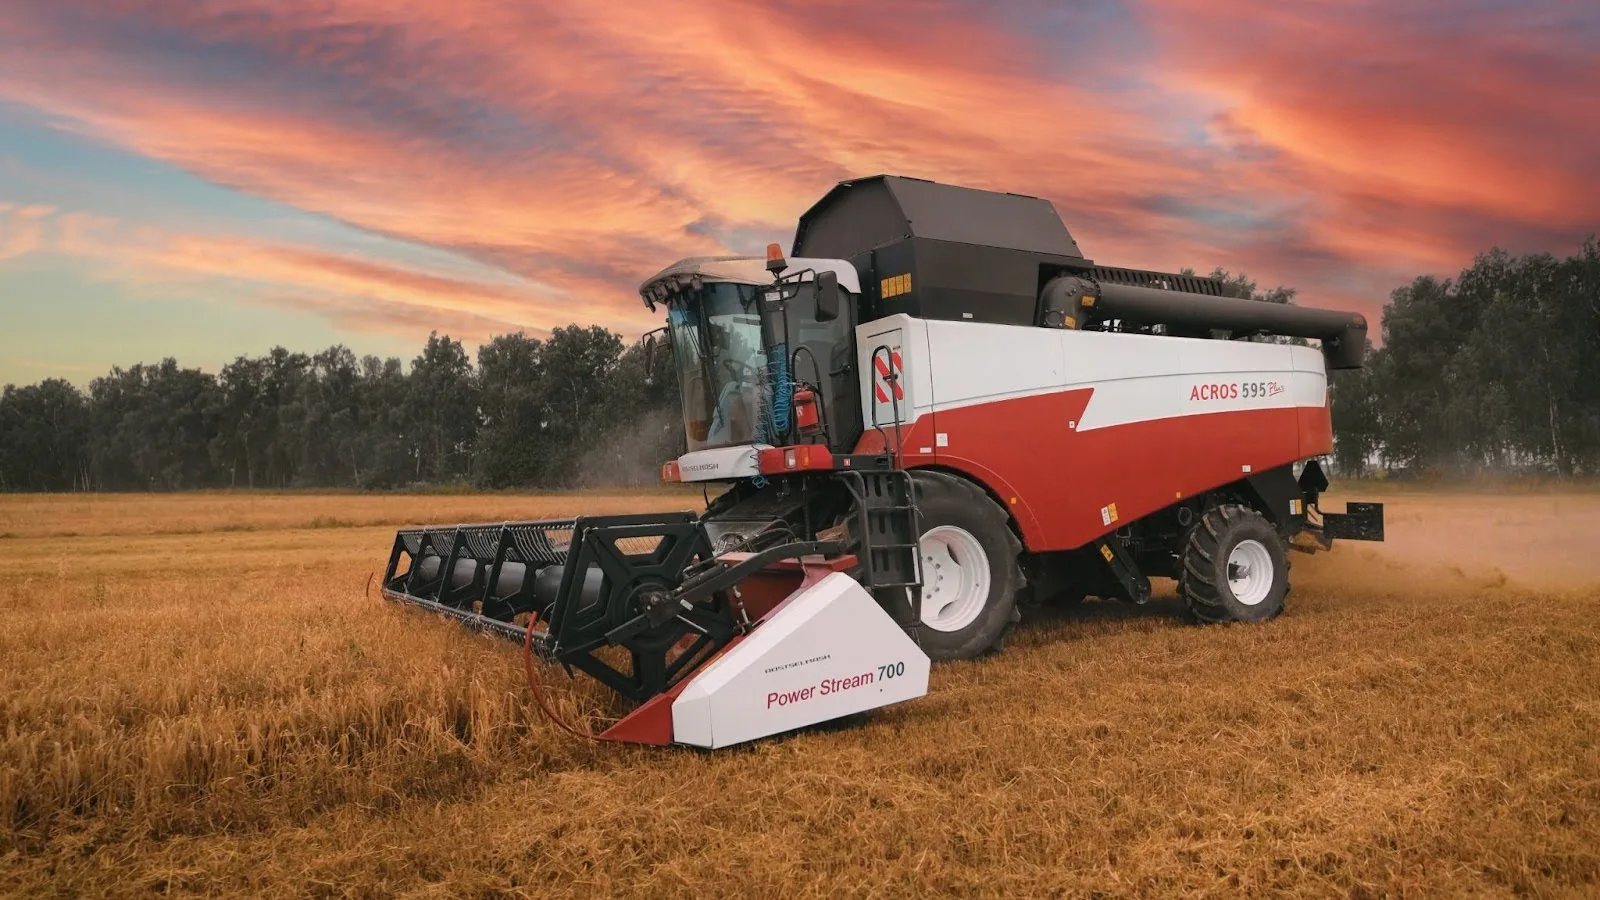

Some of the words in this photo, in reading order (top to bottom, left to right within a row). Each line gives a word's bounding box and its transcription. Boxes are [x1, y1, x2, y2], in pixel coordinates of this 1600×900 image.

[1190, 383, 1238, 401] ACROS
[1242, 382, 1266, 399] 595
[1267, 381, 1285, 396] Plus
[767, 686, 816, 709] Power
[820, 672, 874, 696] Stream
[877, 661, 905, 682] 700
